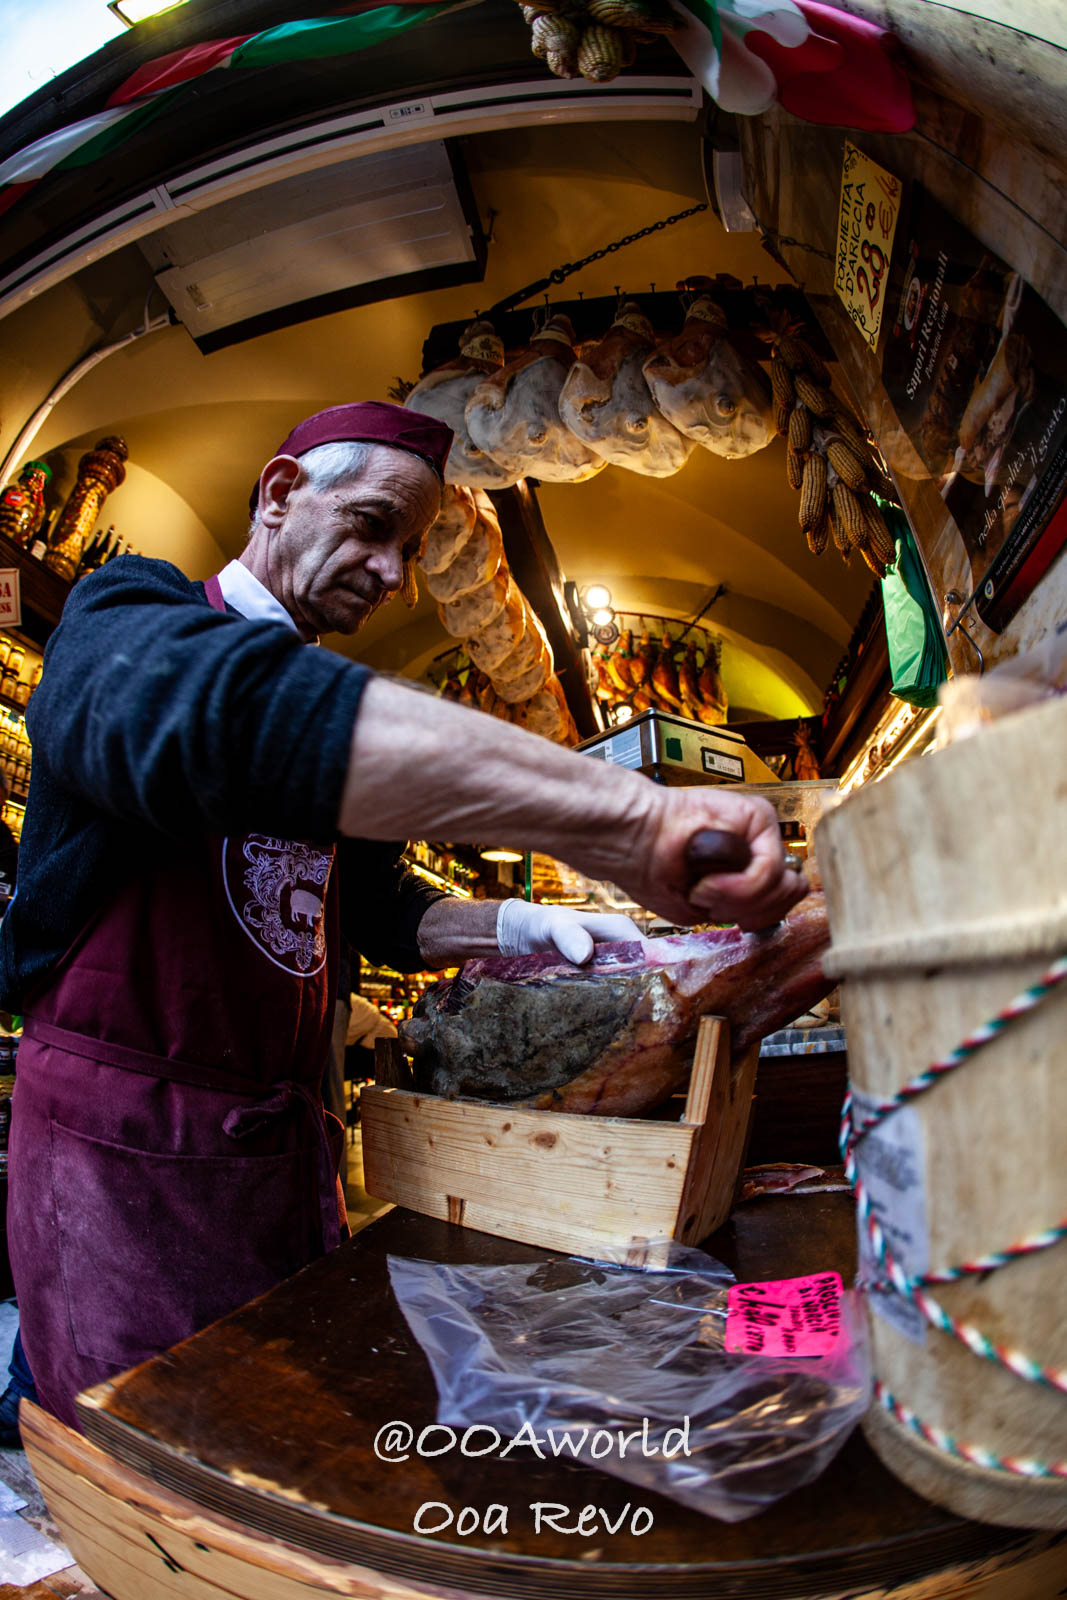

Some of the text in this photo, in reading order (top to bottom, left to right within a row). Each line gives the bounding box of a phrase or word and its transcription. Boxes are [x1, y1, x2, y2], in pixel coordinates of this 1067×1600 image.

[846, 182, 866, 296] D'ARICCIA
[906, 339, 926, 400] Sapori
[921, 250, 949, 341] Regionali
[1030, 445, 1039, 469] il
[1038, 398, 1066, 462] gusto
[978, 509, 998, 546] nella
[266, 837, 298, 850] ANNO
[801, 1300, 828, 1333] NORCIA
